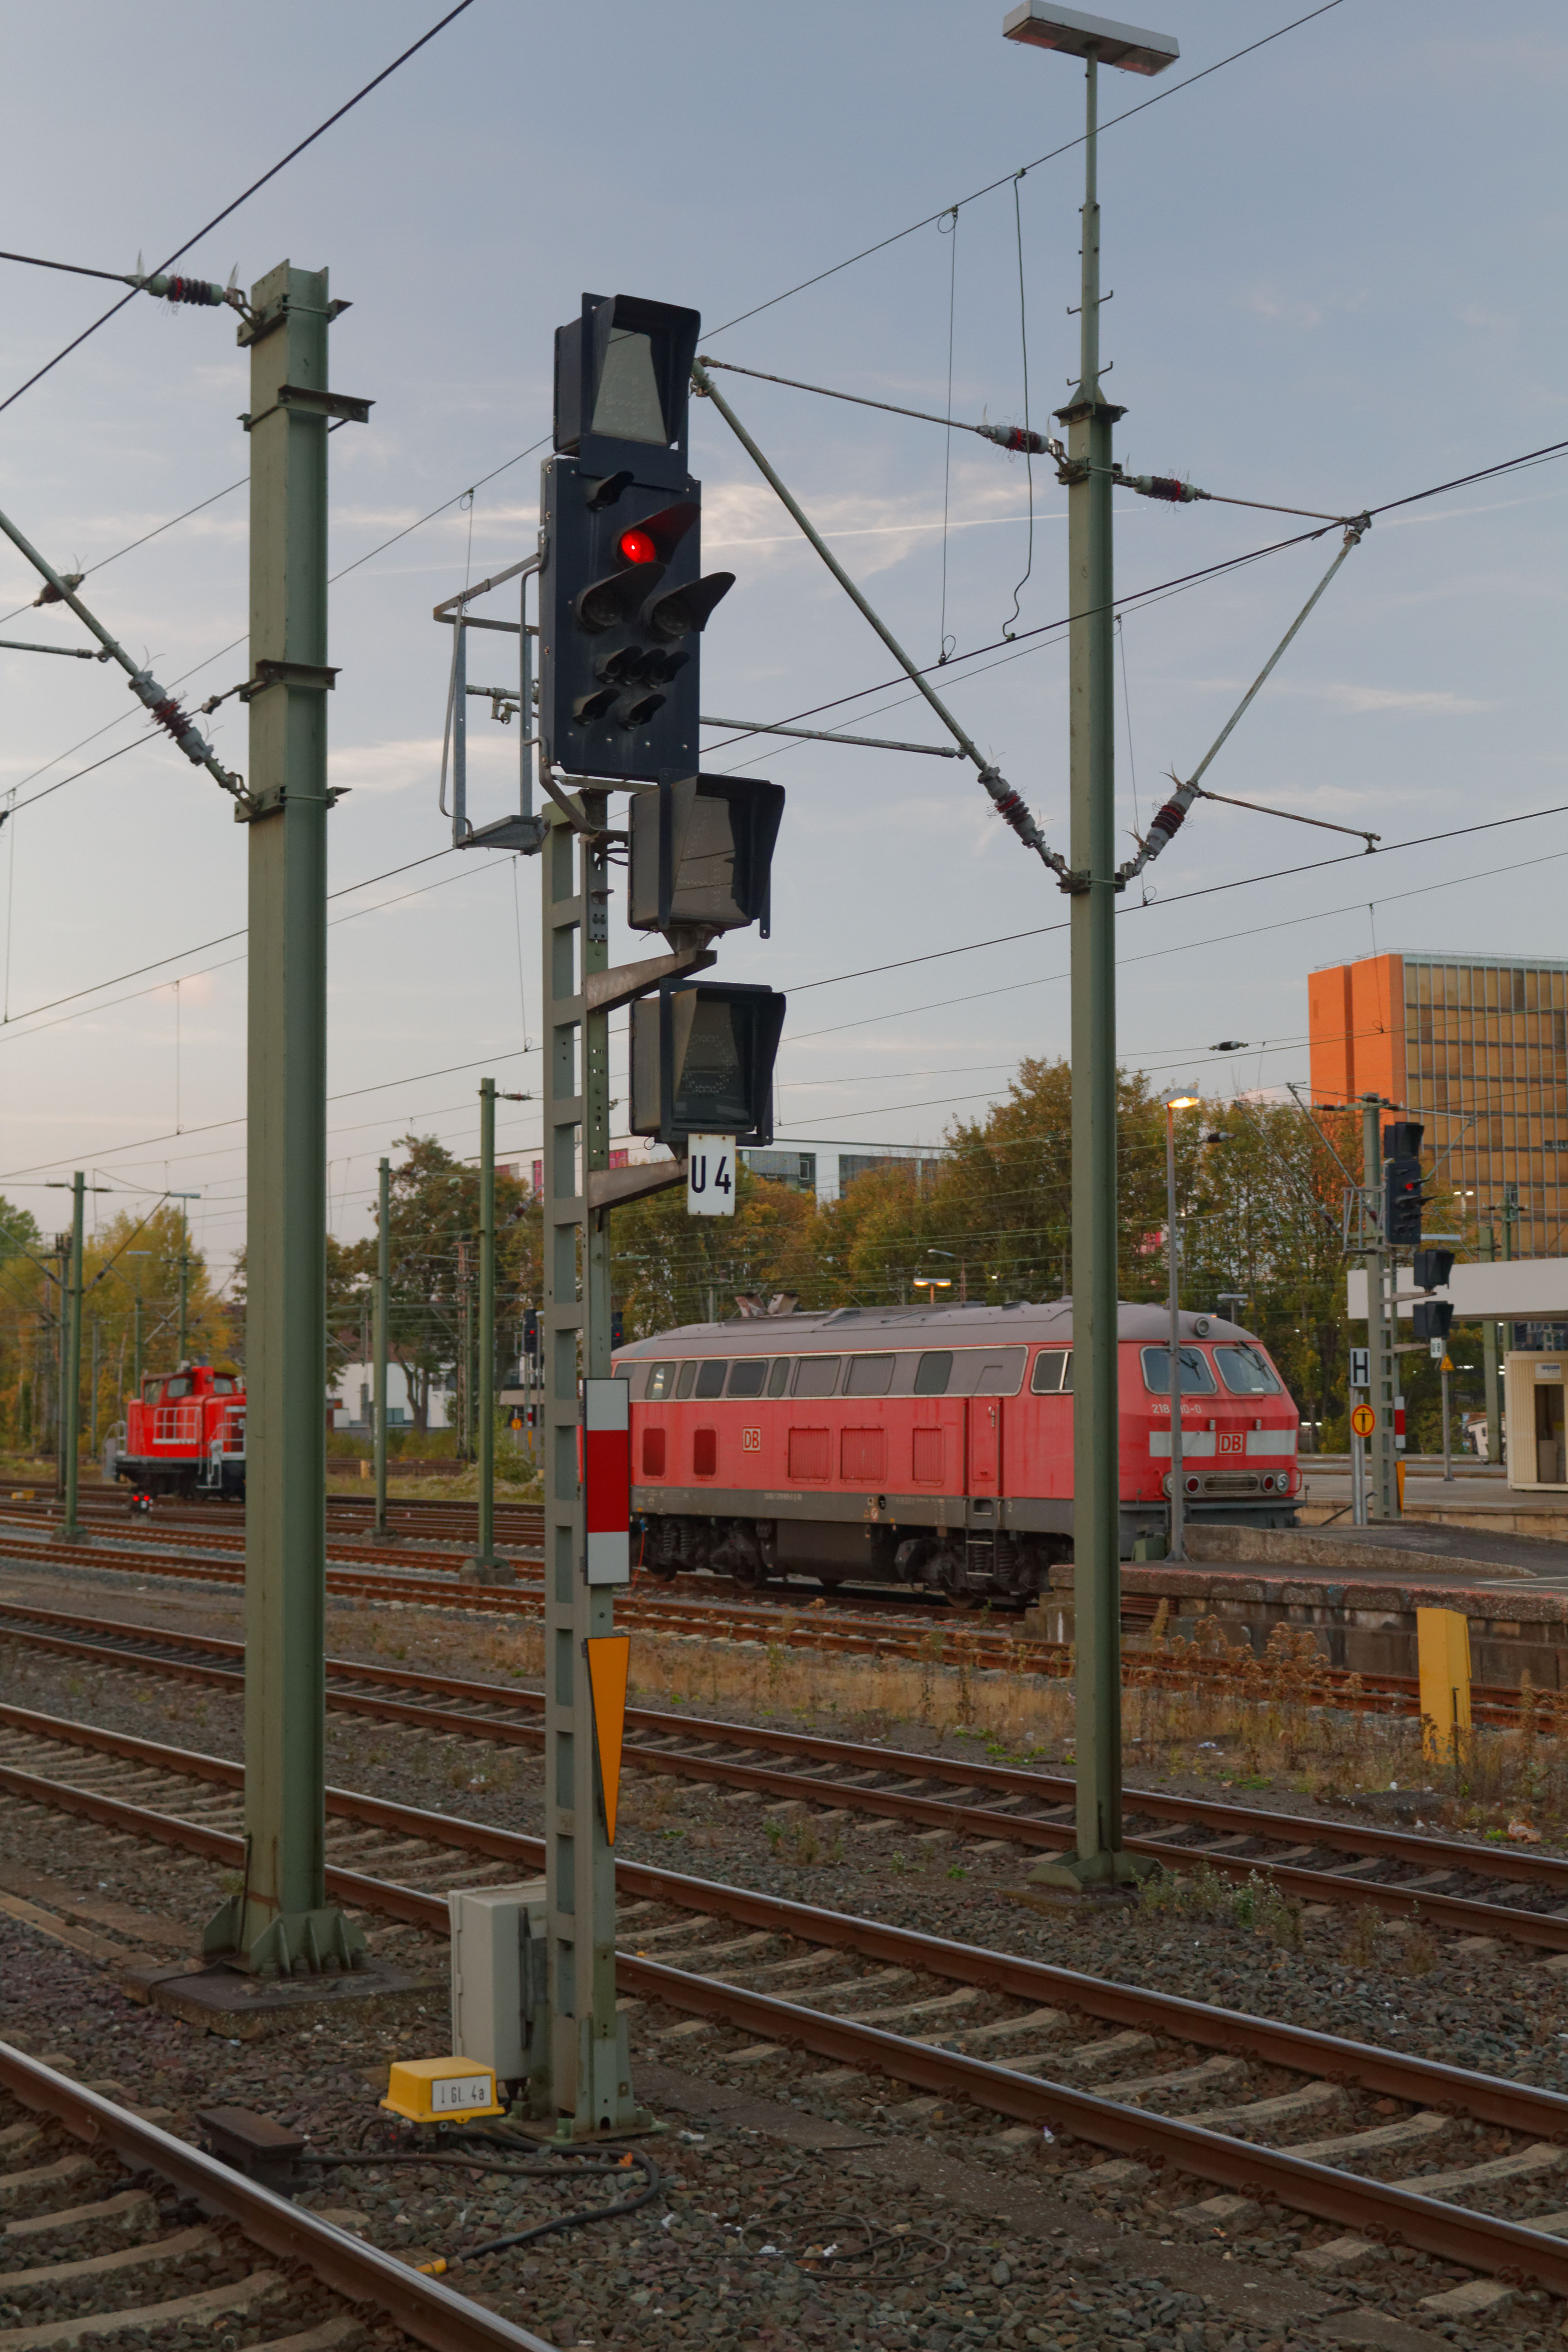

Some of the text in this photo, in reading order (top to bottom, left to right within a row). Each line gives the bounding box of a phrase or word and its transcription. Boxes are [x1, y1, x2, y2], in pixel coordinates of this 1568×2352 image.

[1353, 1351, 1368, 1383] H
[1152, 1404, 1202, 1414] 218 10-0
[745, 1430, 759, 1448] DB
[1221, 1435, 1241, 1451] DB
[1008, 1501, 1013, 1513] 2
[471, 2085, 485, 2100] 4a
